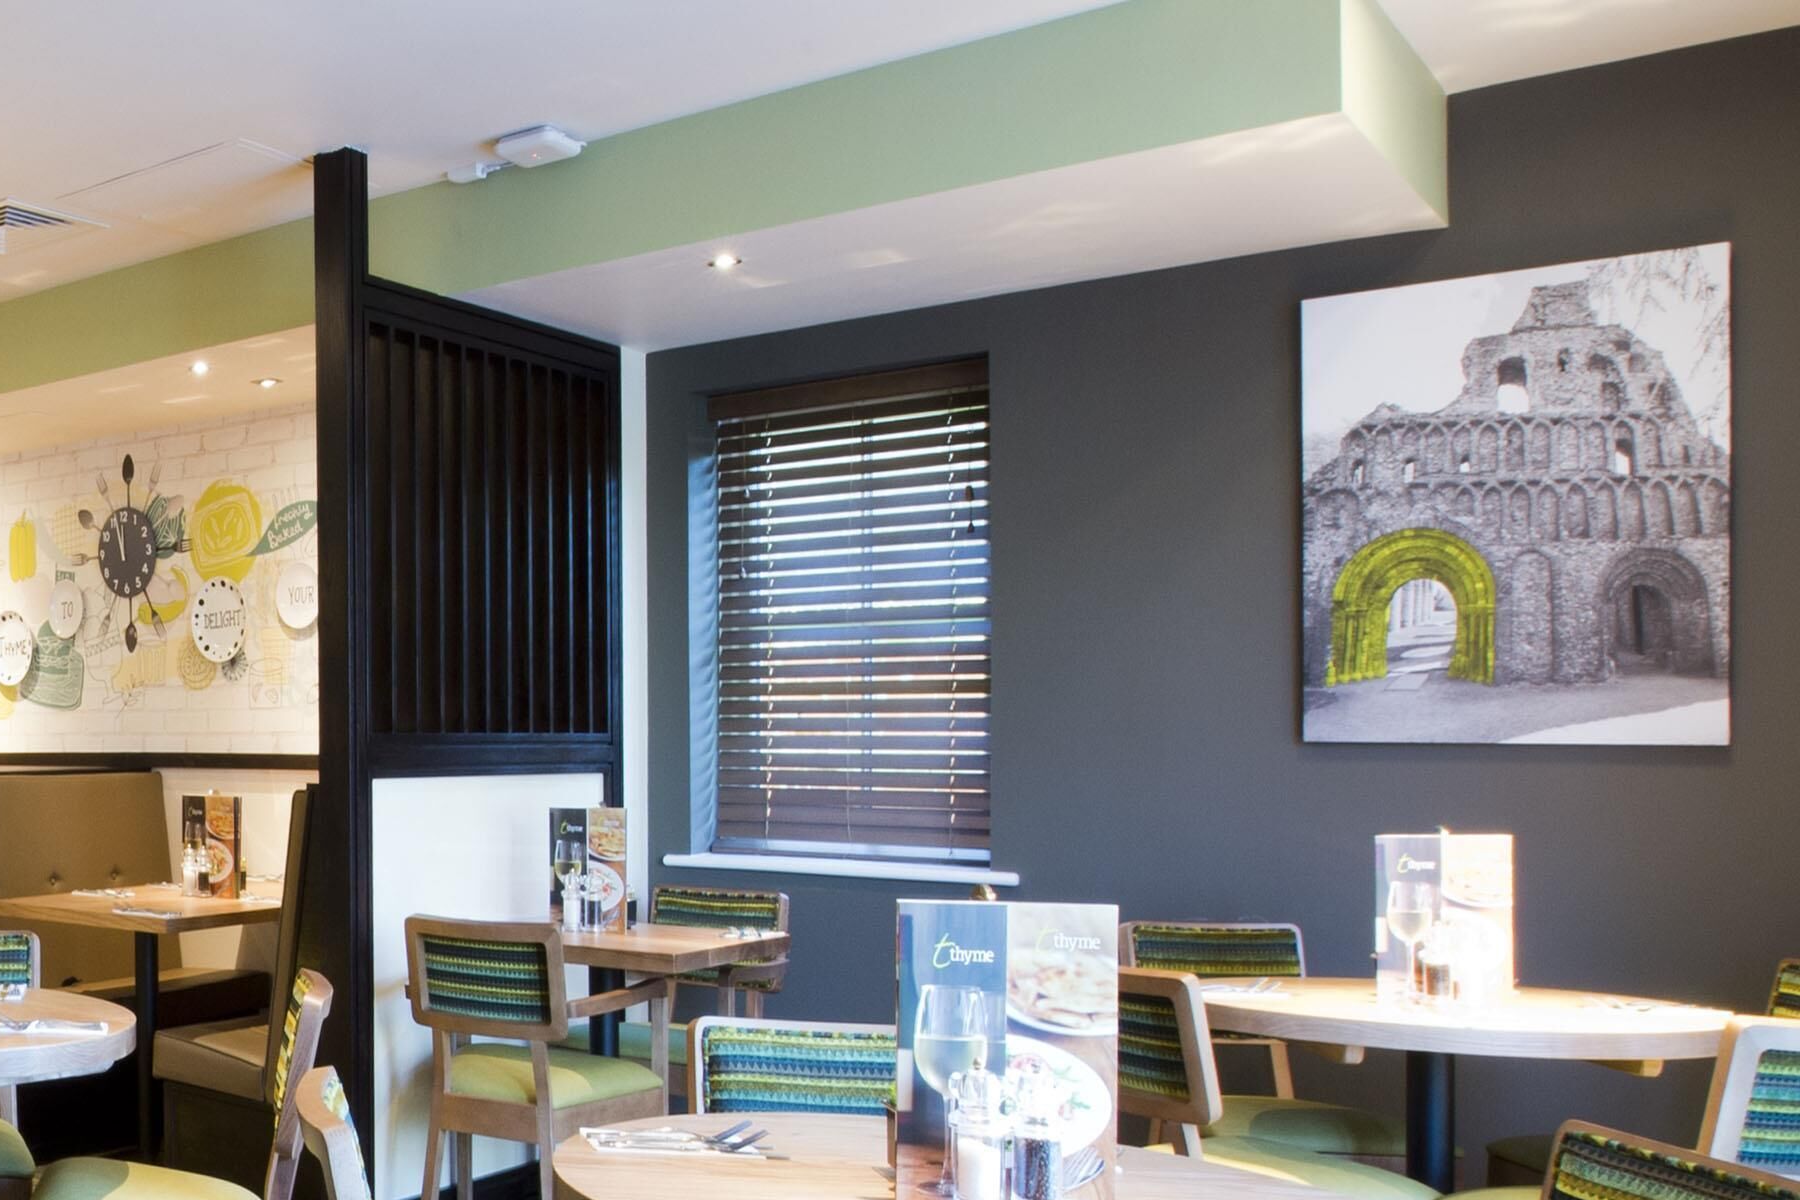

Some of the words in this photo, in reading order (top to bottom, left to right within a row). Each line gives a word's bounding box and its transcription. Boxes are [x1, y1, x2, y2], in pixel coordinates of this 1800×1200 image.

[120, 511, 128, 523] 12
[133, 514, 137, 525] 1
[102, 531, 111, 542] 10
[141, 526, 148, 538] 2
[100, 549, 105, 561] 9
[145, 543, 153, 556] 3
[104, 567, 110, 579] 8
[142, 562, 149, 574] 4
[113, 579, 119, 590] 7
[124, 582, 130, 594] 6
[136, 576, 142, 588] 5
[288, 585, 315, 606] YOUR
[61, 600, 74, 620] TO
[203, 608, 242, 630] DELIGHT
[1053, 933, 1101, 952] thyme
[949, 946, 995, 965] thyme
